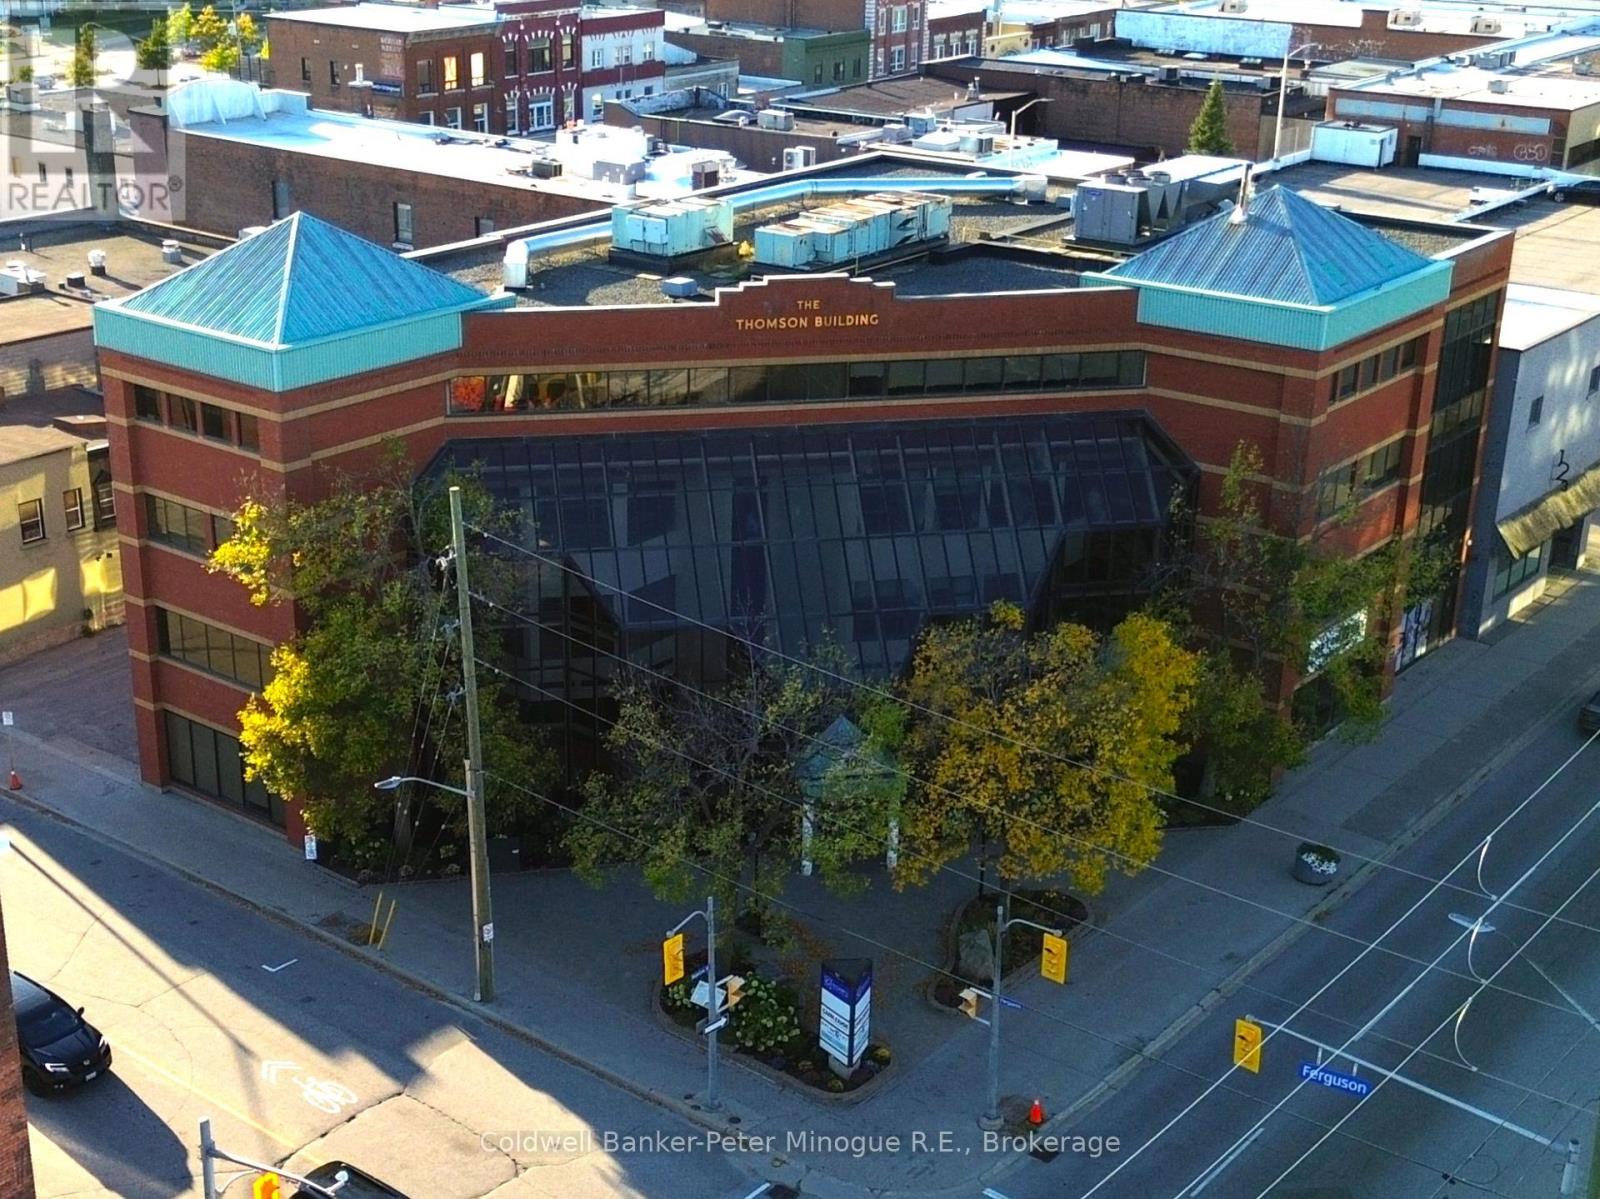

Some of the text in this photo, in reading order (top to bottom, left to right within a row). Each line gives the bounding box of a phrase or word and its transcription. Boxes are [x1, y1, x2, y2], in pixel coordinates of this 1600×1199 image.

[797, 300, 820, 310] THE
[736, 314, 879, 330] THOMSON BUILDING
[1302, 1065, 1367, 1094] Ferguson
